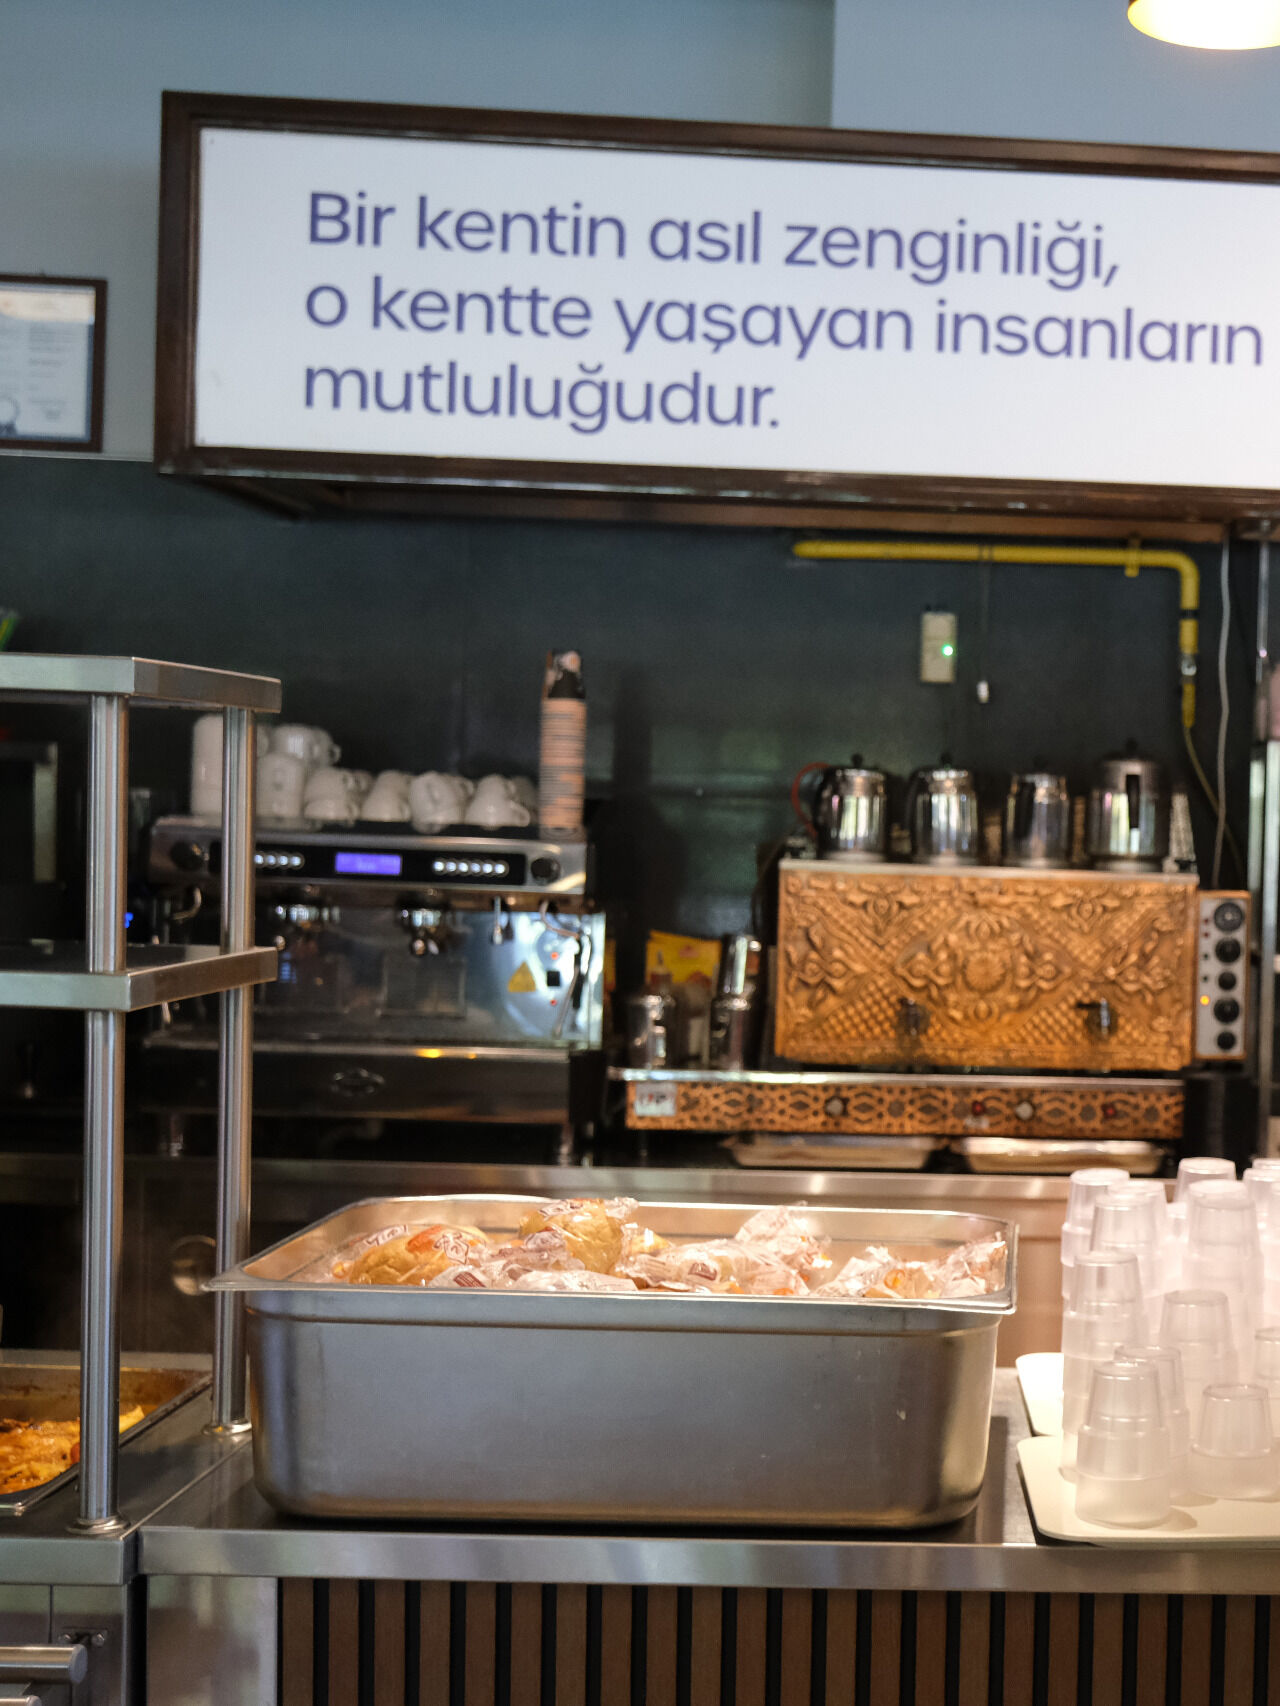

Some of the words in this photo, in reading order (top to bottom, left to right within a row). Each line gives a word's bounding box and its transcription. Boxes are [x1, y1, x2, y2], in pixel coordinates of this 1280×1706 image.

[309, 191, 396, 247] Bir
[417, 195, 626, 258] kentin
[650, 210, 761, 264] asıl
[785, 218, 1118, 291] zenginliği,
[305, 284, 348, 327] o
[372, 275, 592, 338] kentte
[614, 299, 912, 359] yaşayan
[938, 299, 1261, 364] insanların
[305, 360, 778, 434] mutluluğudur.
